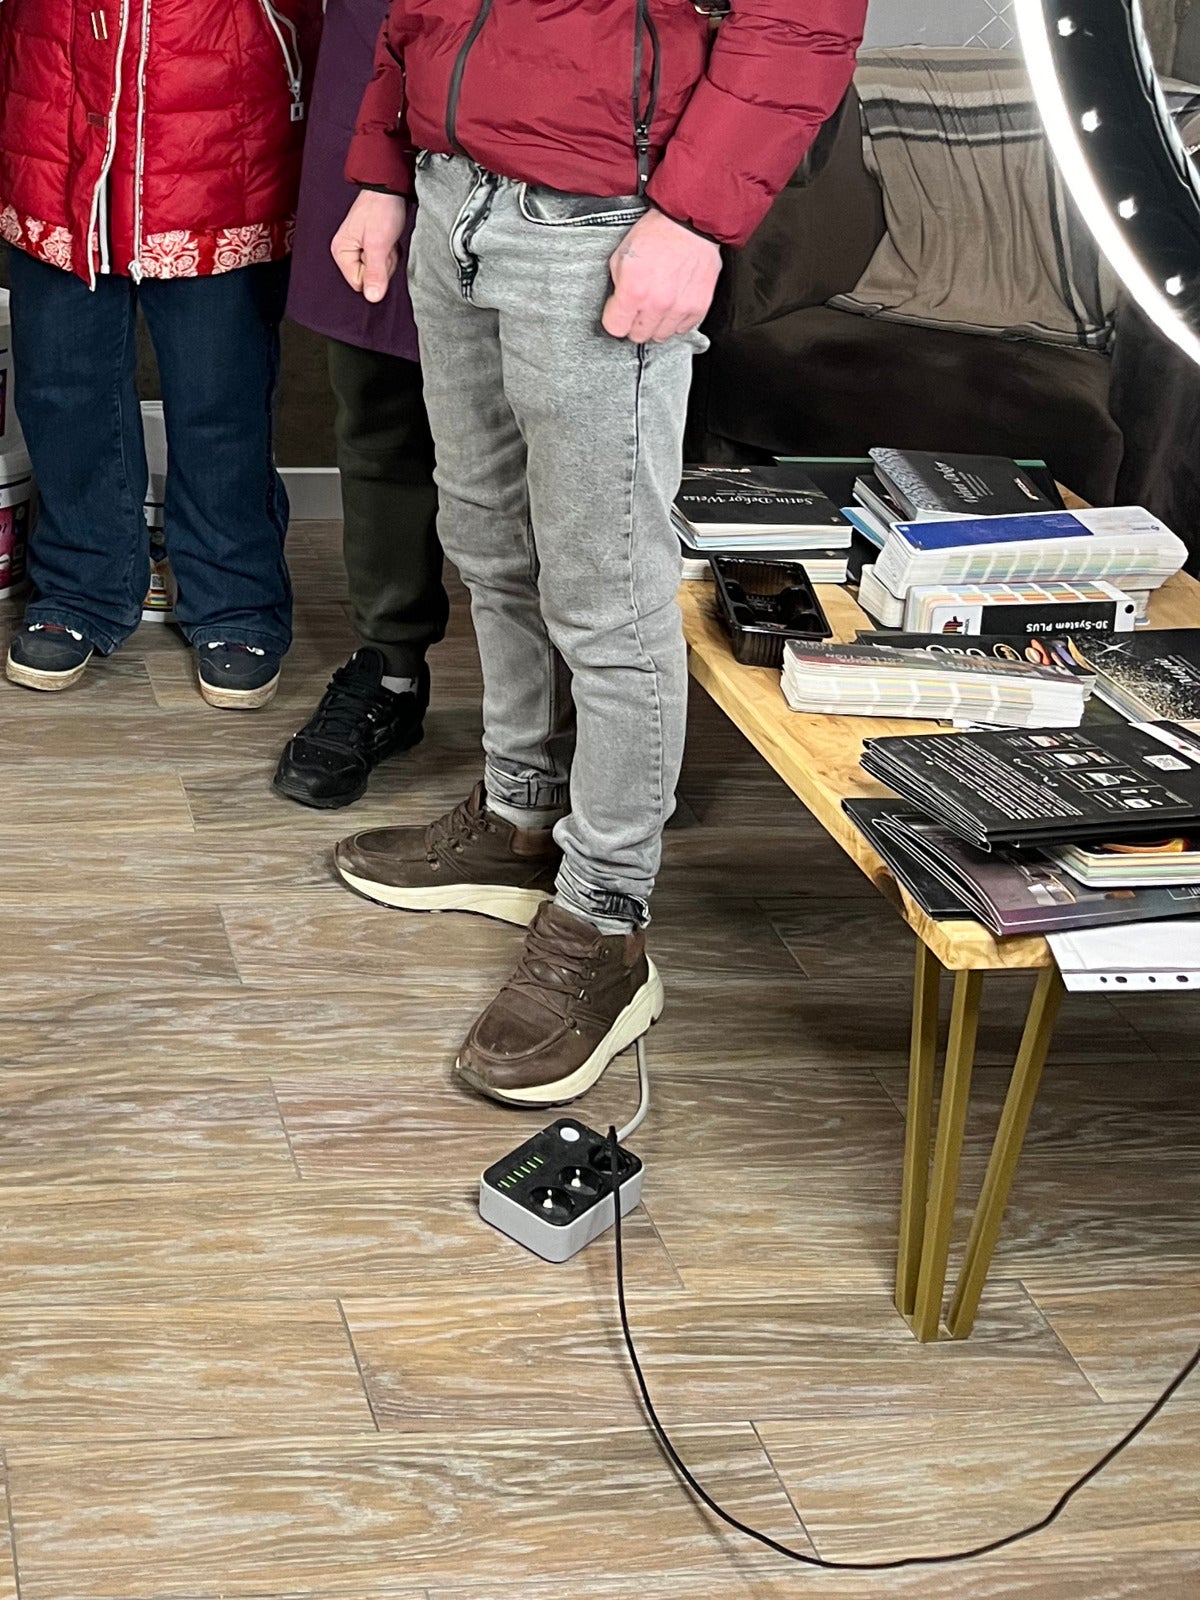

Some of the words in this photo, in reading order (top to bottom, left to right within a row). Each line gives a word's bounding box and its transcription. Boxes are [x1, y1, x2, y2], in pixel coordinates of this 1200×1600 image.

[728, 495, 774, 505] Dekor
[1025, 622, 1053, 633] PLUS
[1055, 619, 1109, 634] 3D-System
